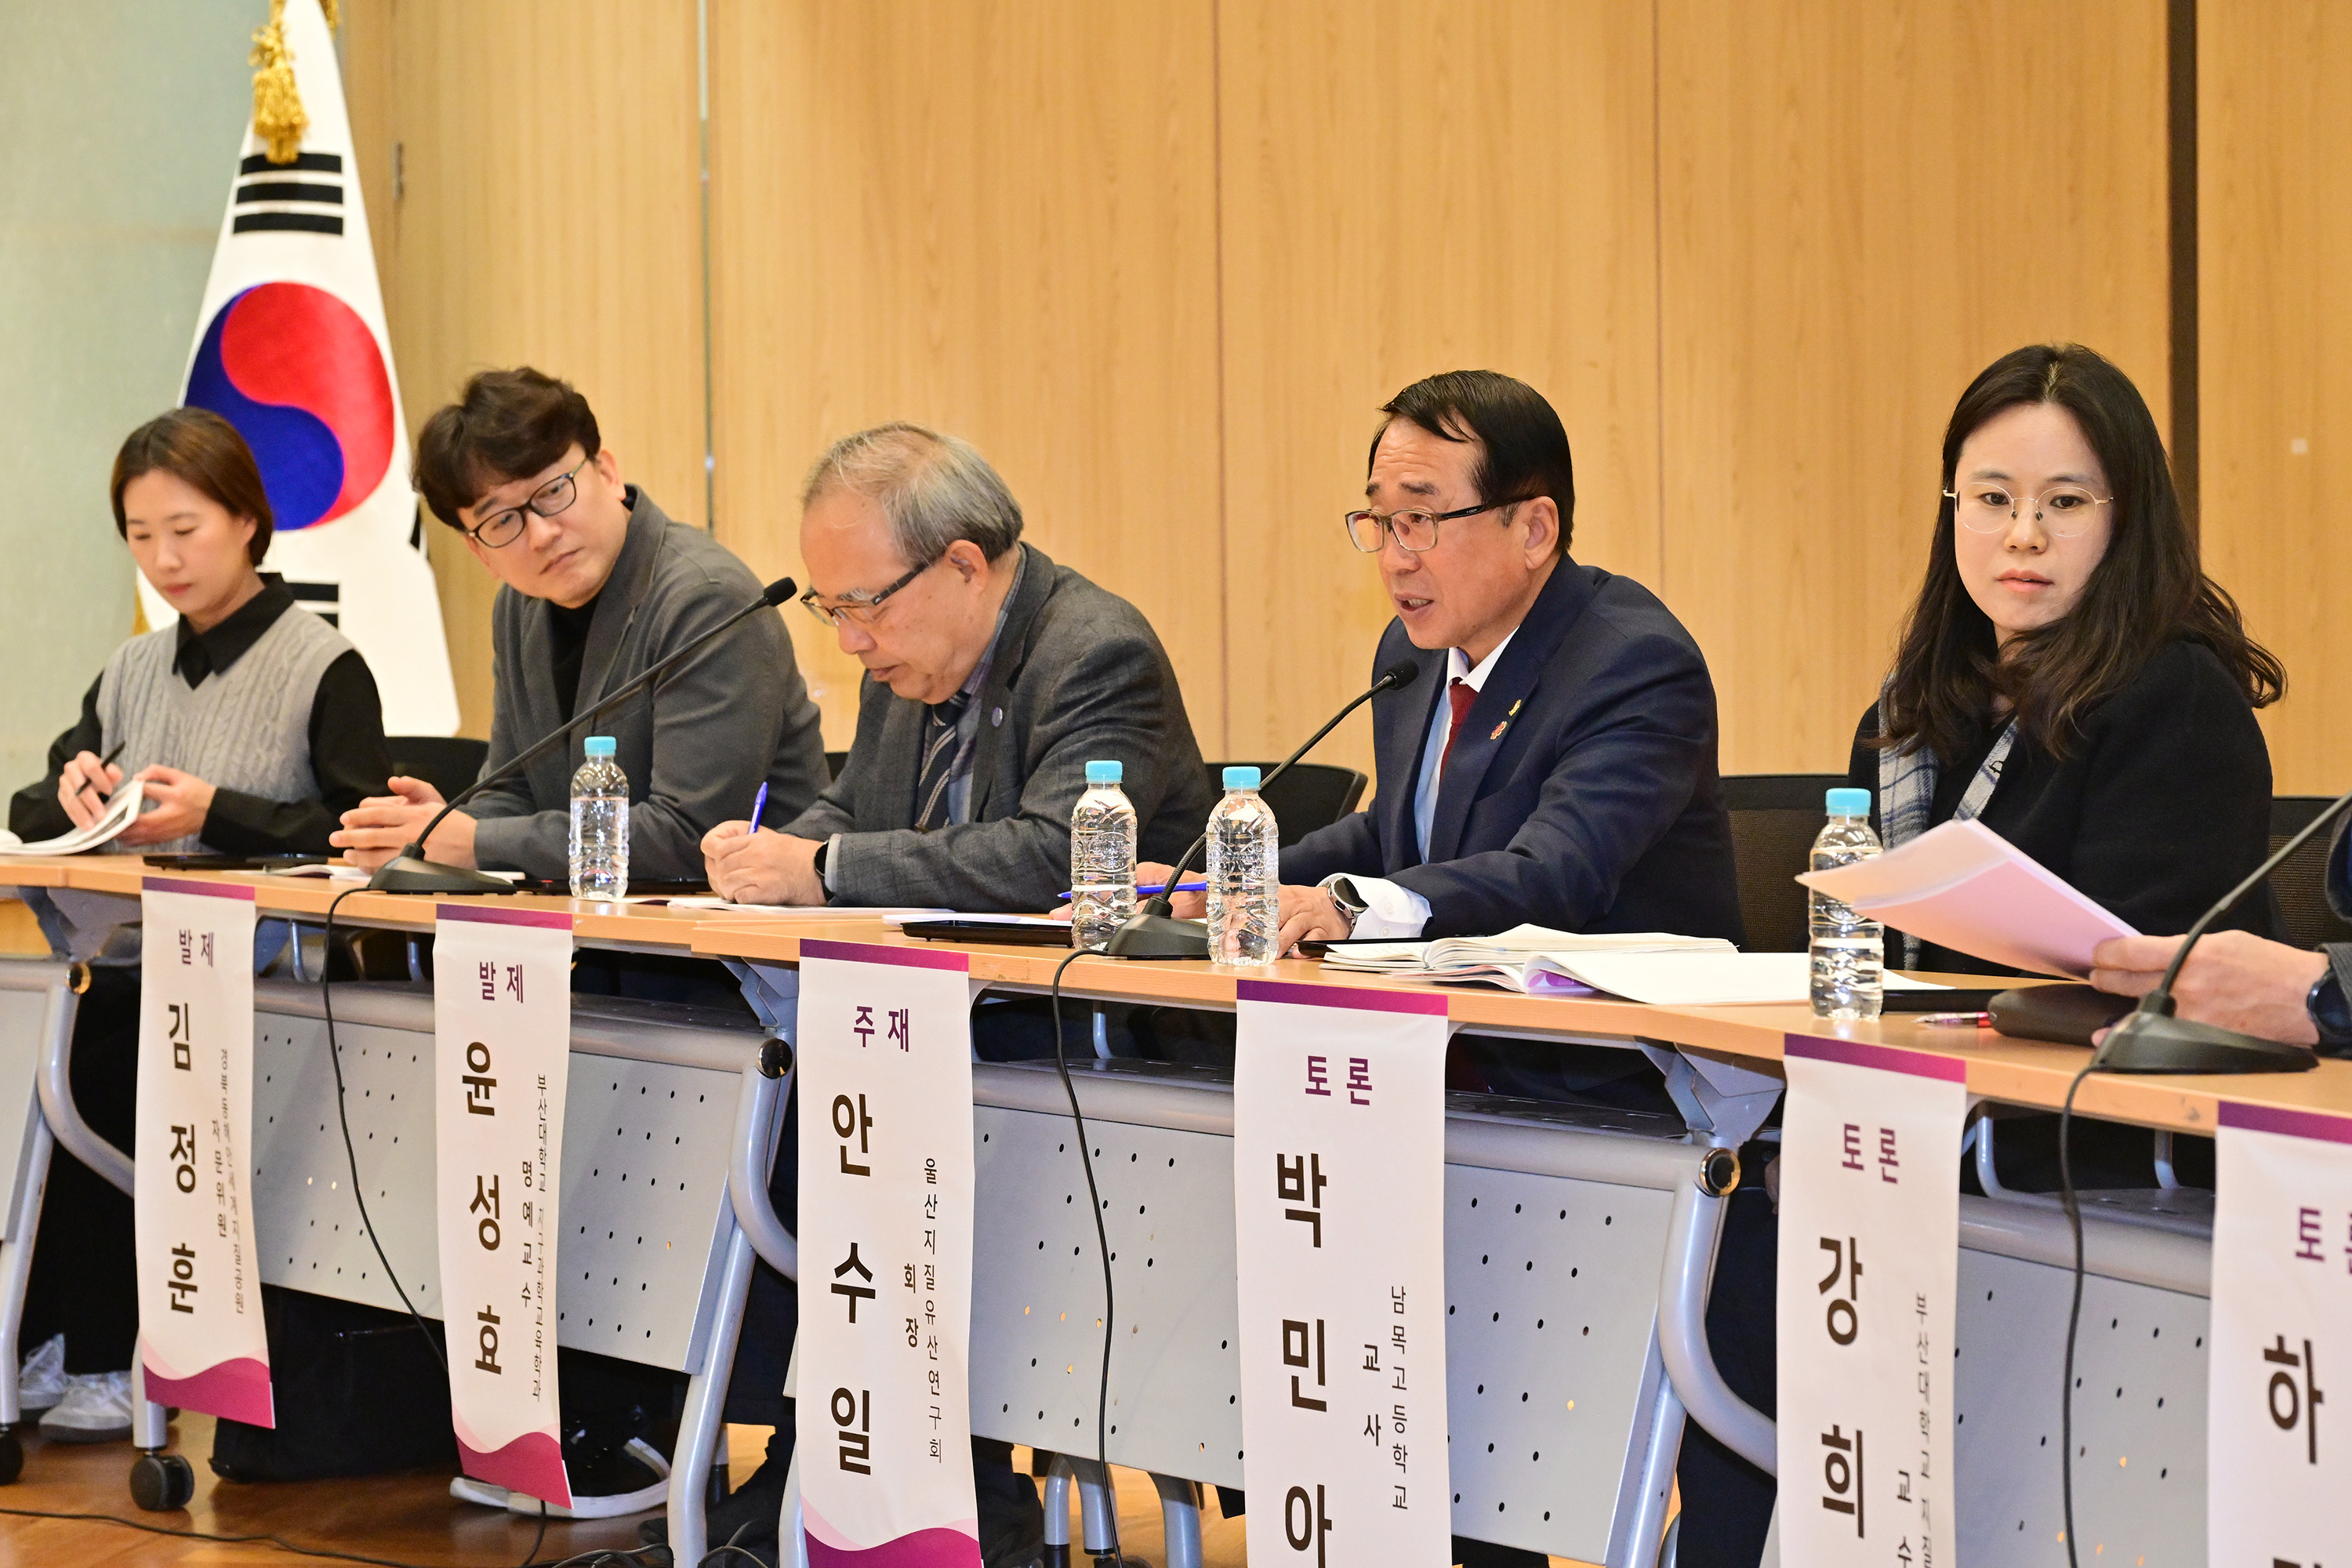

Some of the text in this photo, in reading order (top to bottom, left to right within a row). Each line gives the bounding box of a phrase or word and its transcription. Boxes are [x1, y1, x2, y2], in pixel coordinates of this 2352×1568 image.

[179, 928, 214, 969] 발제
[479, 960, 524, 1004] 발제
[853, 1005, 909, 1053] 주재
[1305, 1054, 1373, 1106] 토론
[167, 1003, 198, 1315] 김정훈
[536, 1073, 548, 1192] 부산대학교
[1842, 1123, 1900, 1185] 토론
[461, 1041, 503, 1376] 윤성효
[521, 1160, 534, 1308] 명예교수
[830, 1093, 877, 1476] 안수일
[903, 1262, 920, 1348] 회장
[924, 1157, 942, 1464] 울산지질유산연구회
[1276, 1152, 1333, 1568] 박민아
[1362, 1343, 1382, 1447] 교사
[1391, 1285, 1409, 1511] 남목고등학교
[1915, 1293, 1931, 1479] 부산대학교
[2263, 1334, 2325, 1568] 하
[1896, 1469, 1913, 1568] 교수
